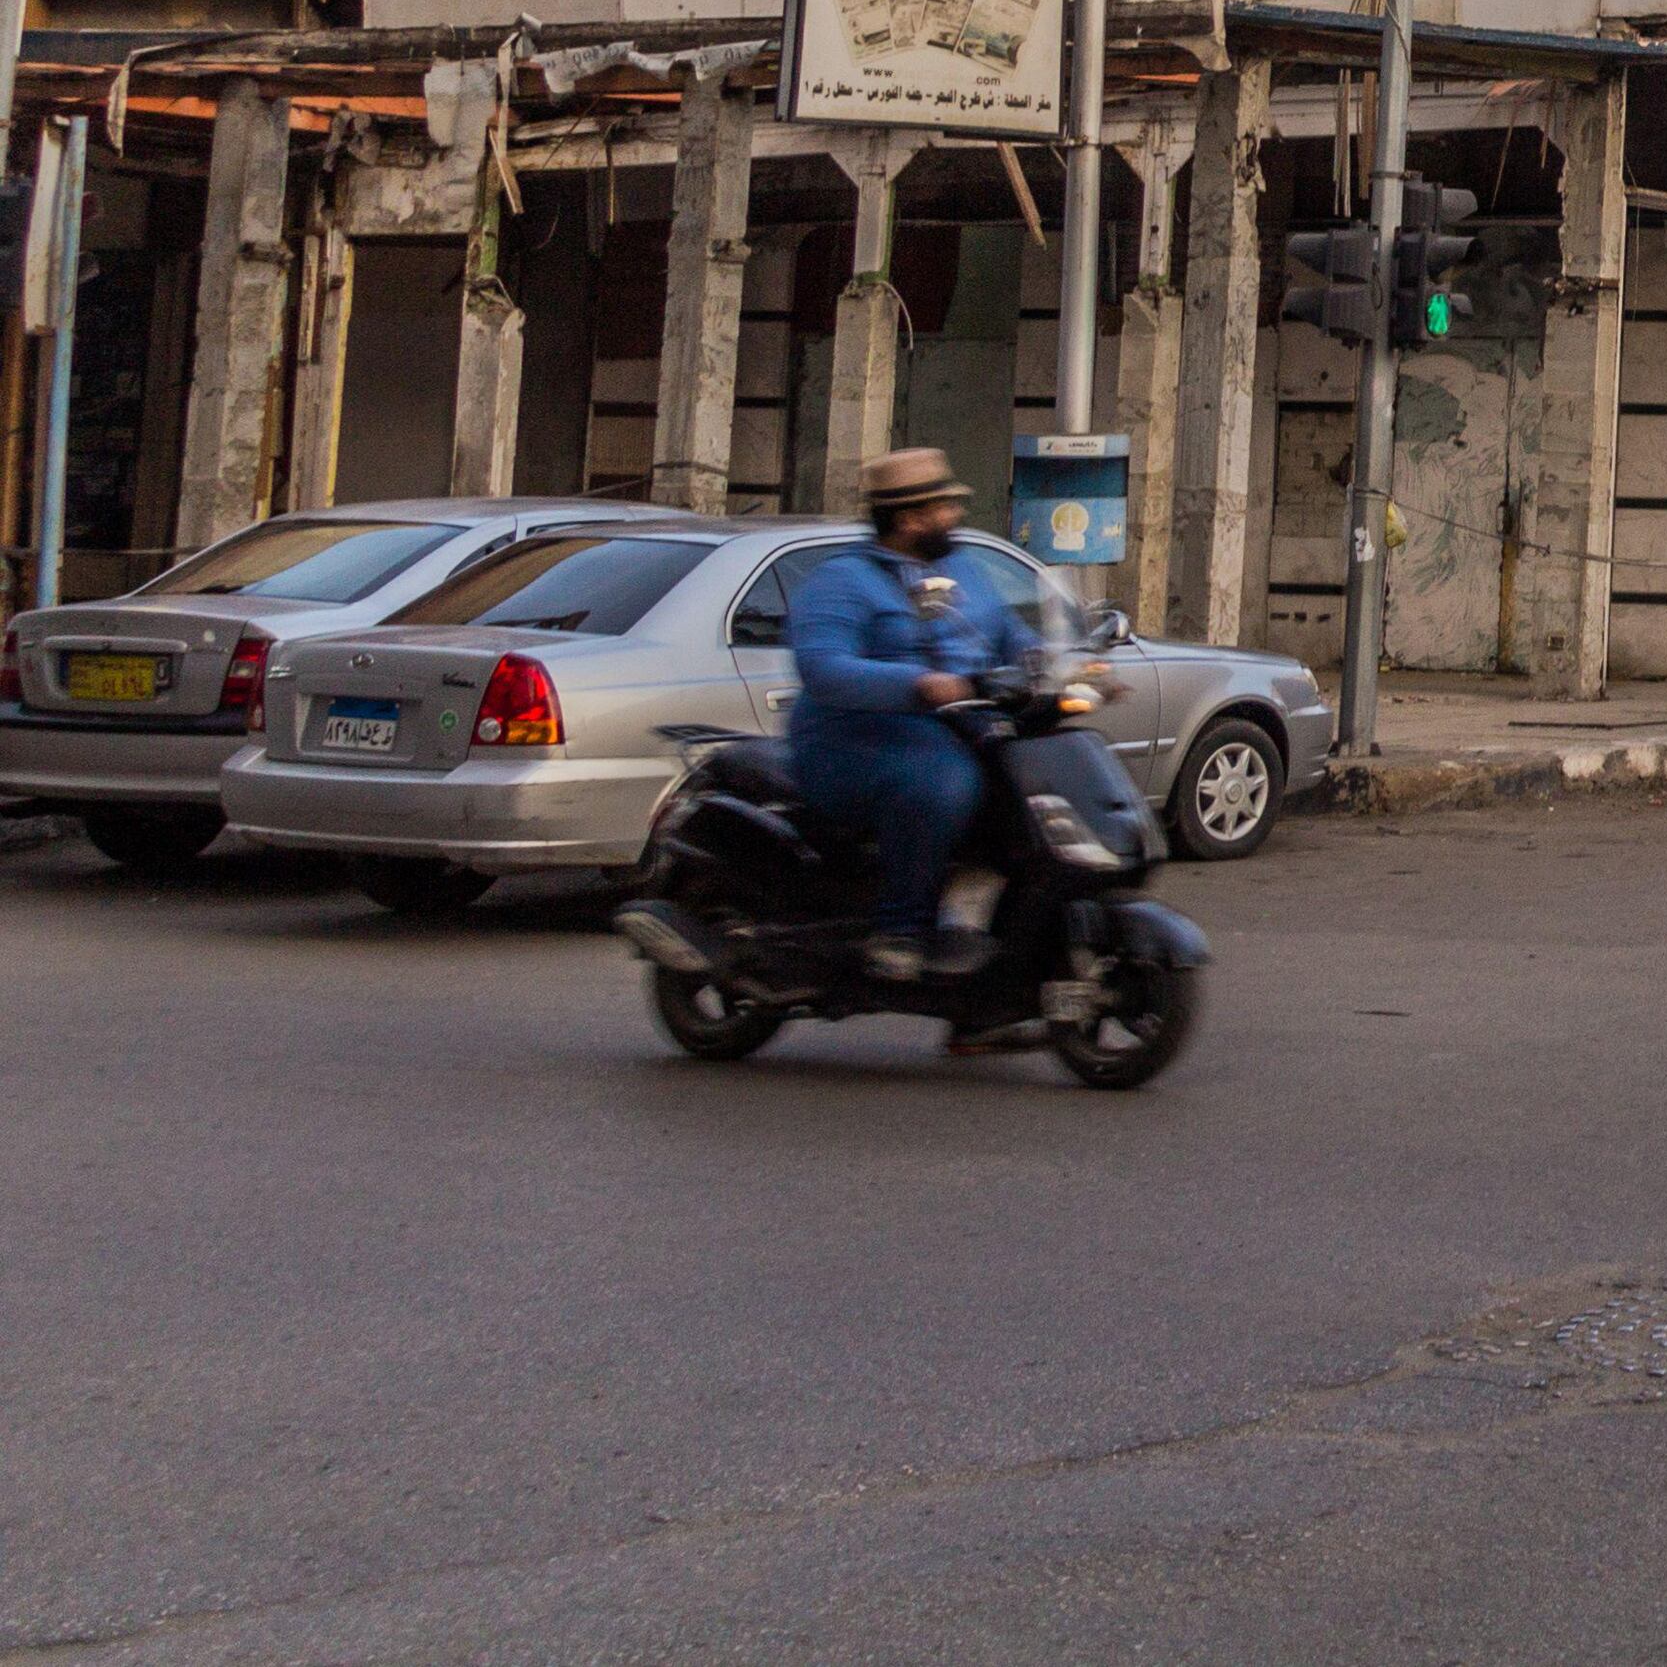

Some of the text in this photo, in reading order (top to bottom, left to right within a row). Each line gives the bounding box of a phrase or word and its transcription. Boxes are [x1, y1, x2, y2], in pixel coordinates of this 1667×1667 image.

[812, 78, 831, 98] رقم
[833, 81, 854, 99] محل
[960, 91, 981, 111] طرح
[1036, 93, 1052, 112] مقر
